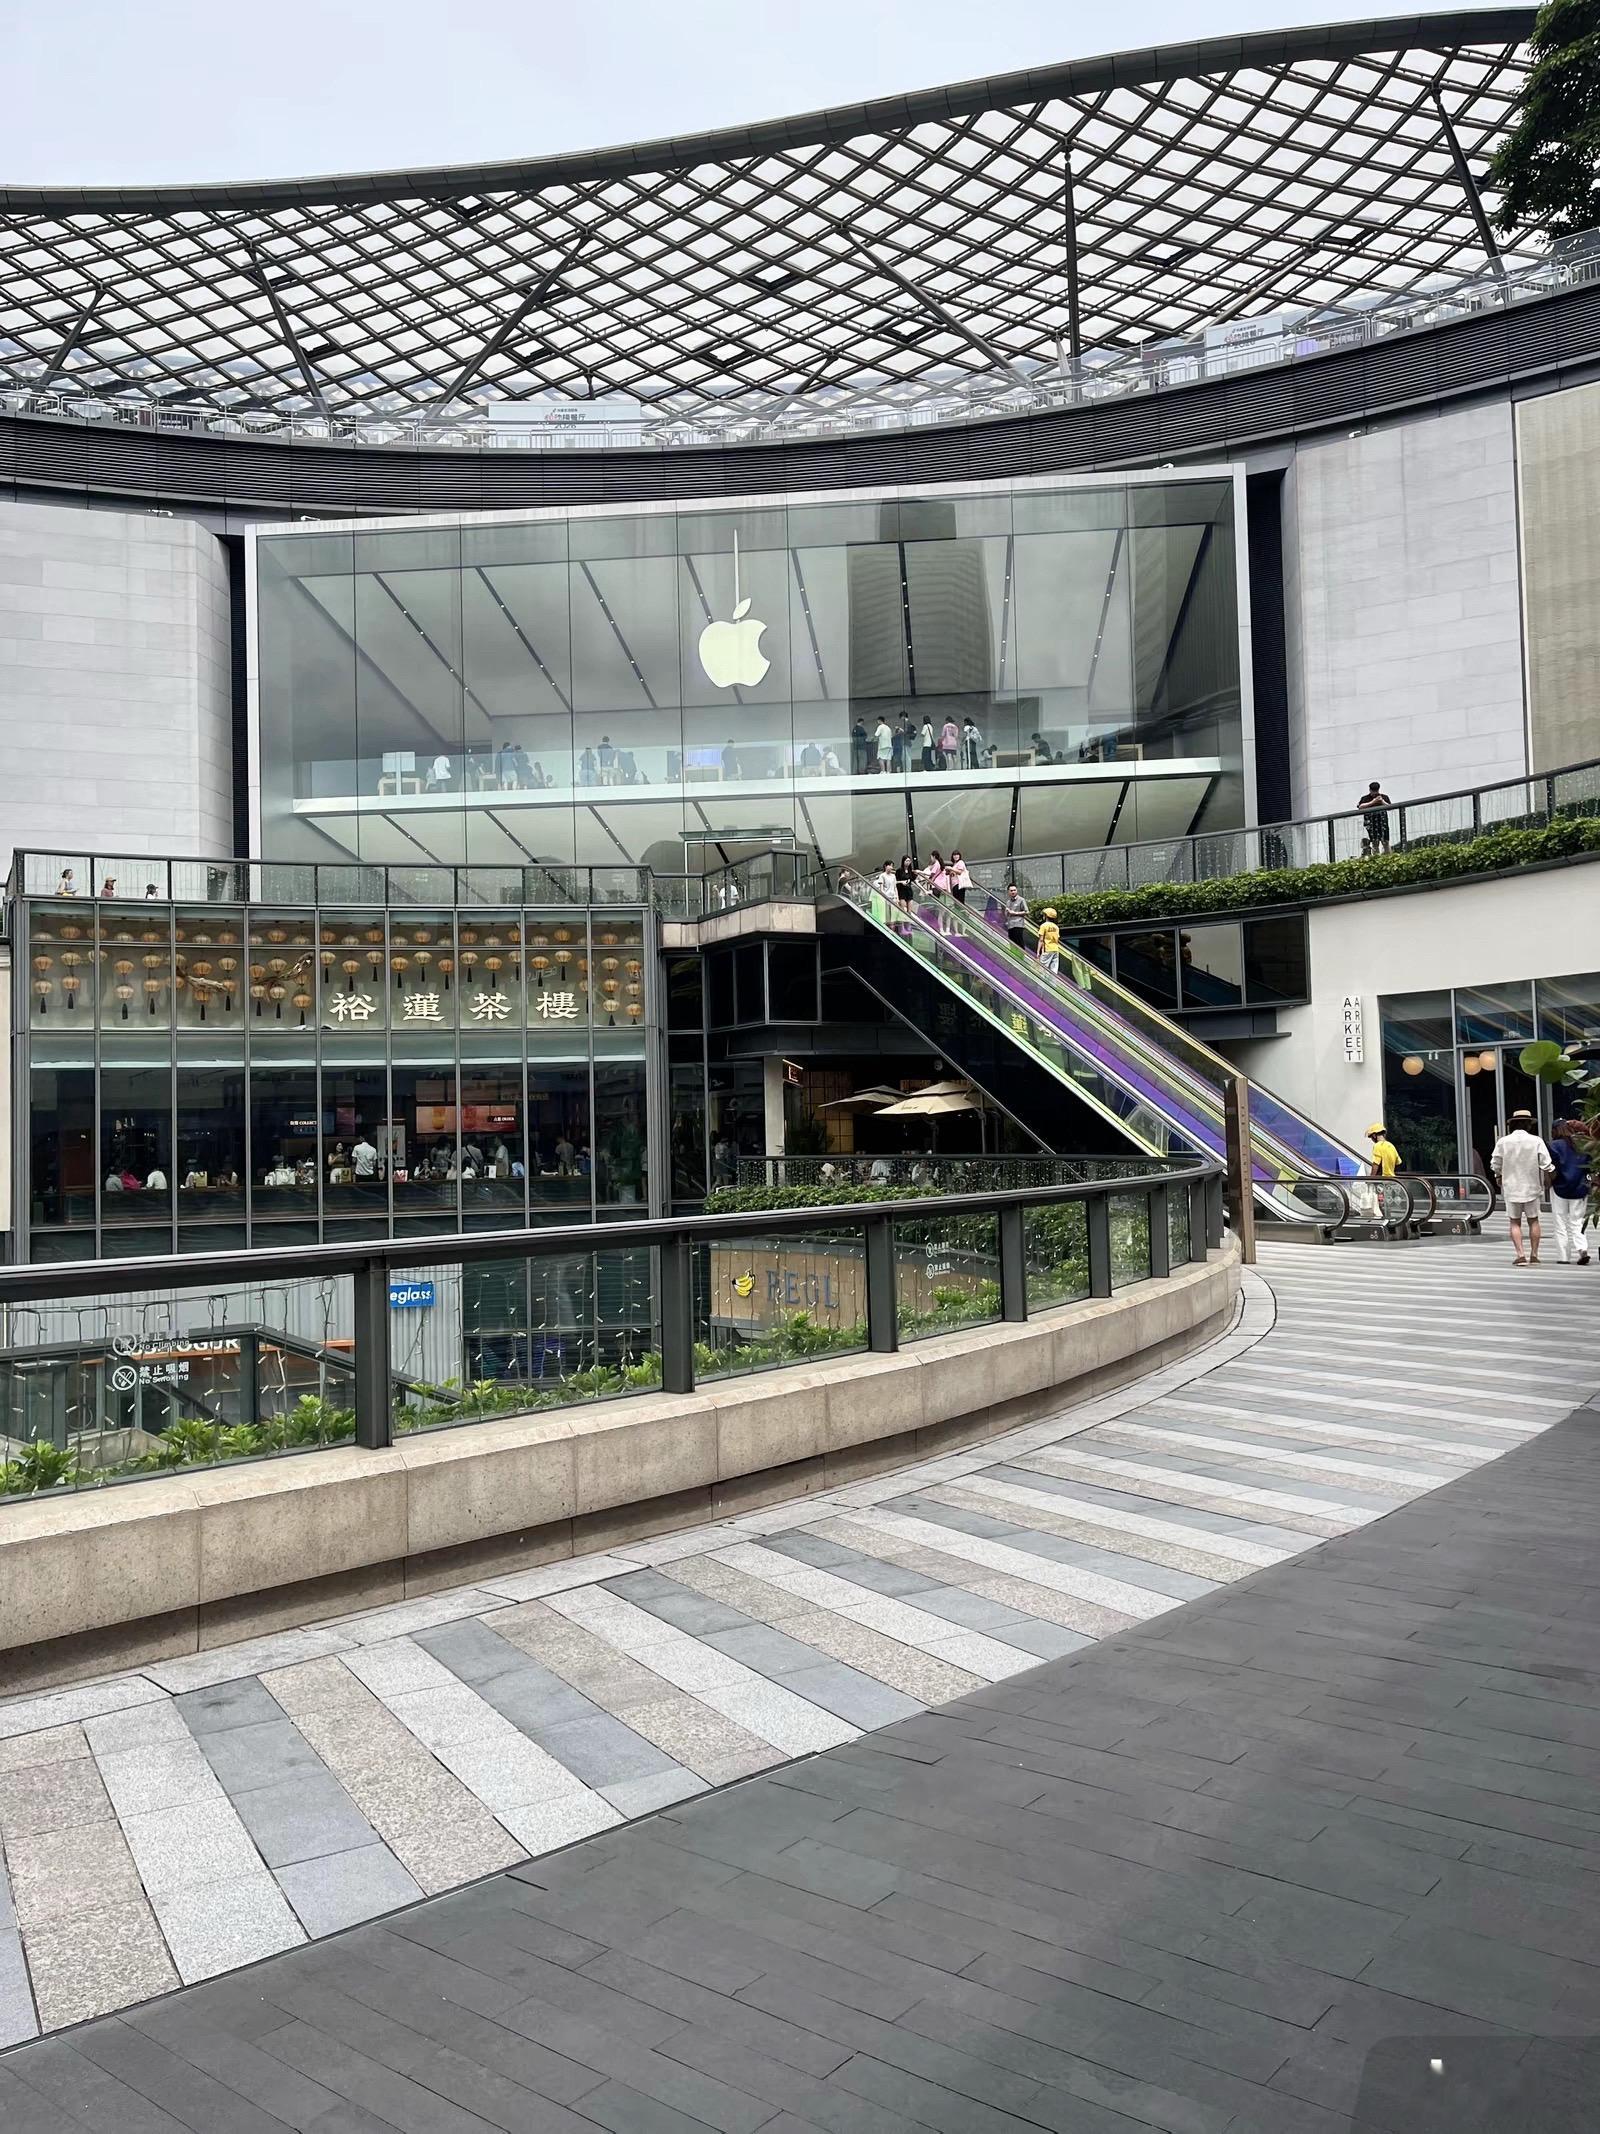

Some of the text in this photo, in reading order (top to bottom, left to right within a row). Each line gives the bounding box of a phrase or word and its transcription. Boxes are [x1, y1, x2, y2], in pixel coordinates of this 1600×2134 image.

[329, 992, 580, 1023] 裕蓮茶樓
[1343, 997, 1354, 1061] ARKET
[139, 1373, 189, 1385] No Smoking
